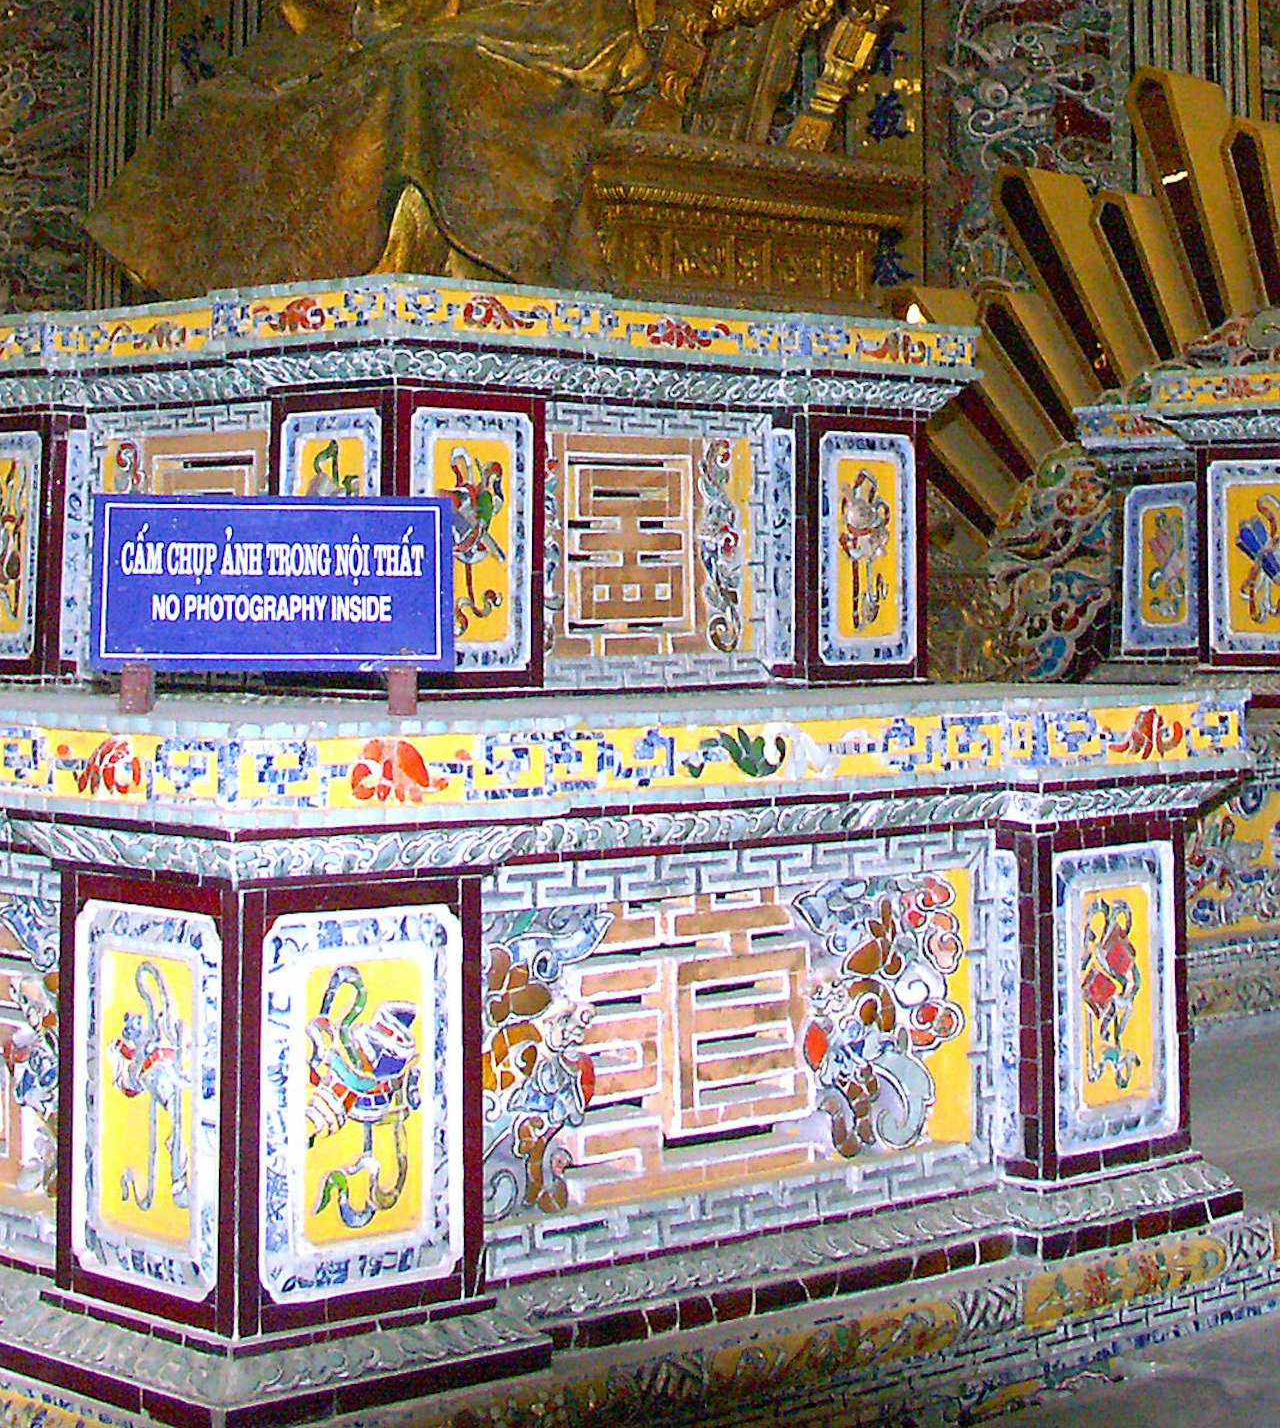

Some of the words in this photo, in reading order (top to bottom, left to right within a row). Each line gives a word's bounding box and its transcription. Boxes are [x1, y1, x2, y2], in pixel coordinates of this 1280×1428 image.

[121, 523, 163, 576] CẤM
[167, 542, 218, 585] CHỤP
[220, 526, 264, 576] ẢNH
[266, 542, 332, 577] TRONG
[334, 533, 370, 586] NỘI
[374, 525, 424, 578] THẤT
[151, 593, 180, 621] NO
[184, 594, 327, 622] PHOTOGRAPHY
[331, 595, 393, 622] INSIDE
